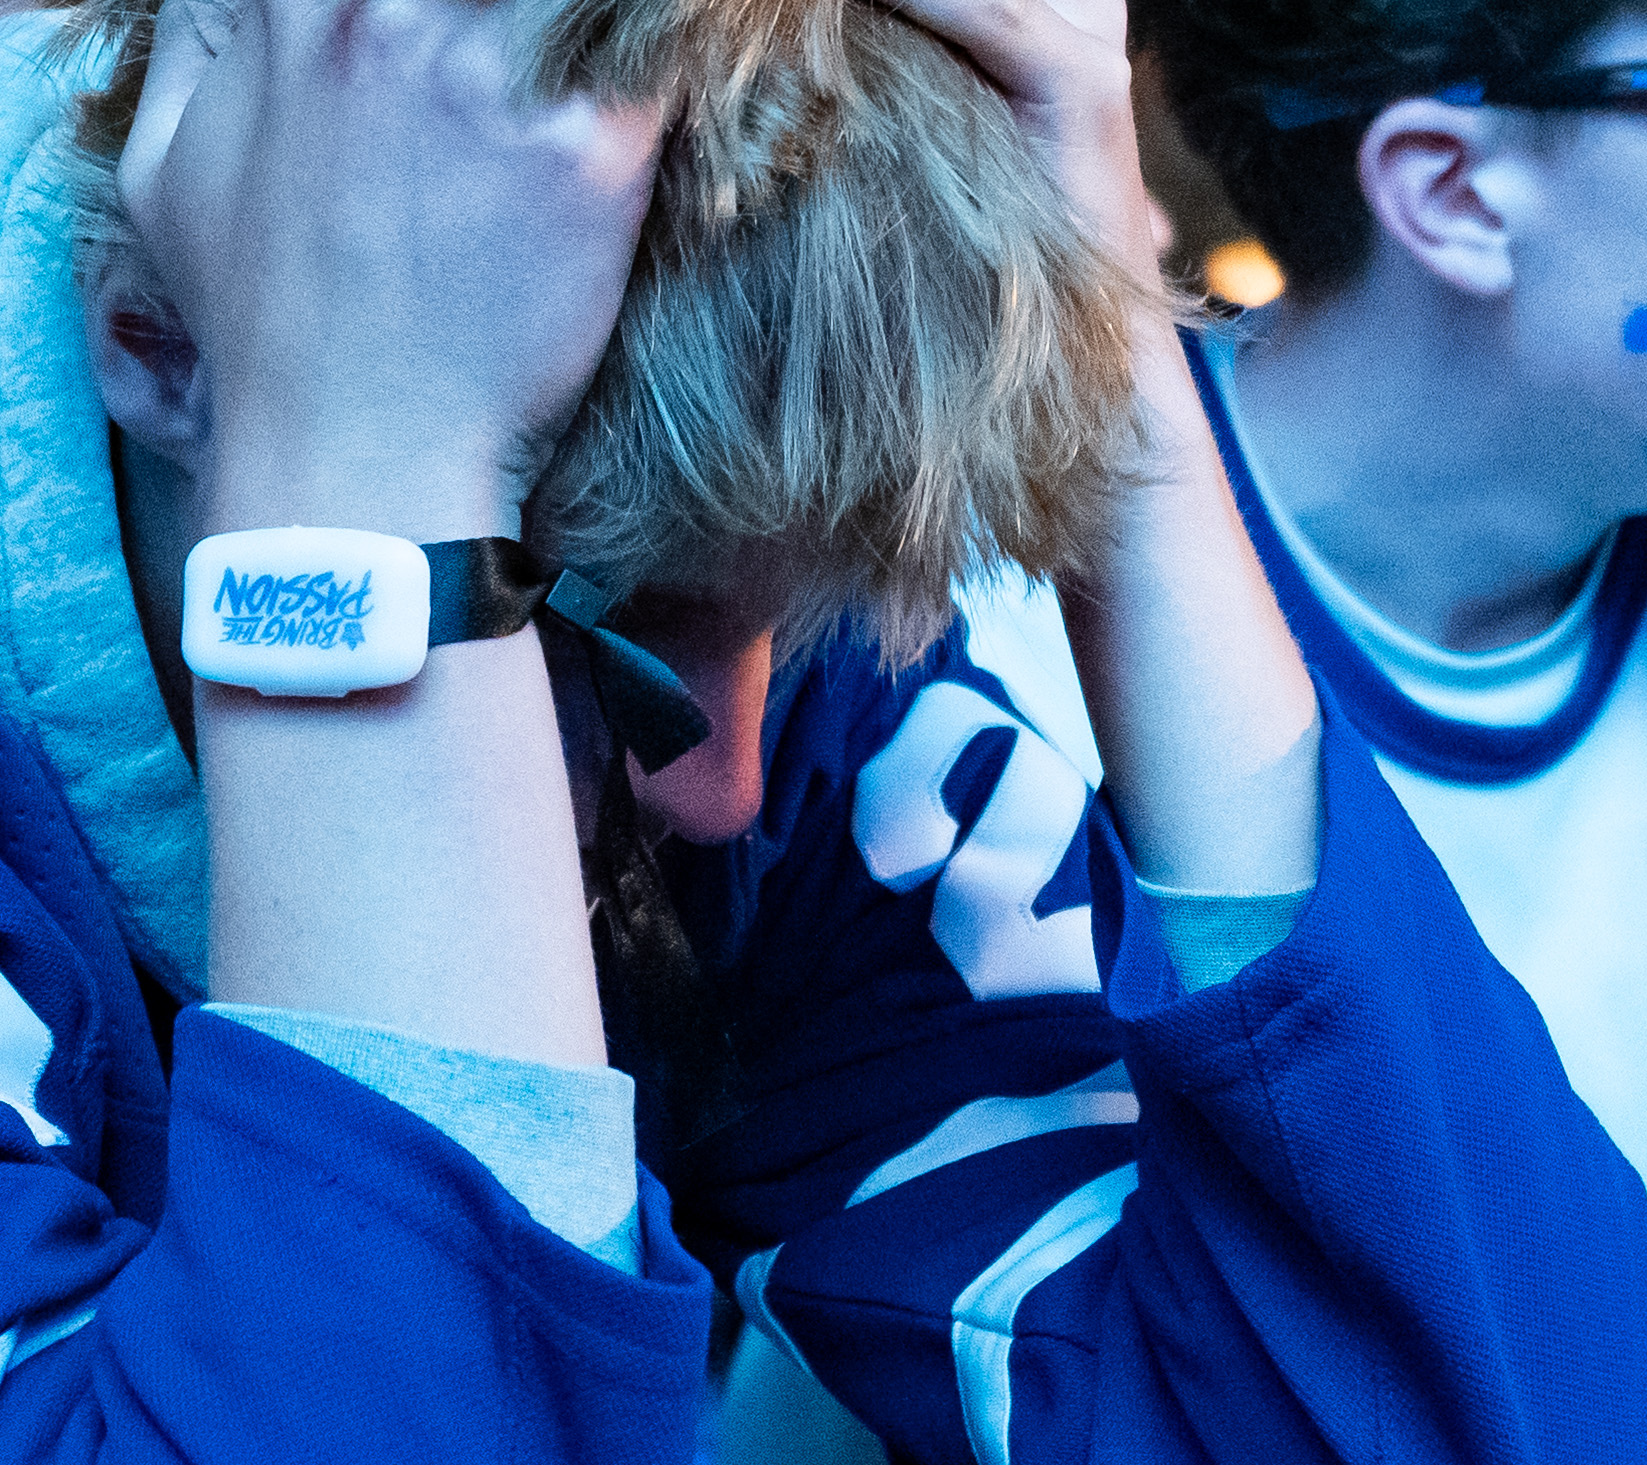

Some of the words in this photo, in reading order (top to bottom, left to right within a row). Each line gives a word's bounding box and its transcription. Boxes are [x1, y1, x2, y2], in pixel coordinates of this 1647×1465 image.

[212, 567, 374, 621] PASSION
[218, 616, 263, 646] THE
[259, 614, 344, 651] BRING
